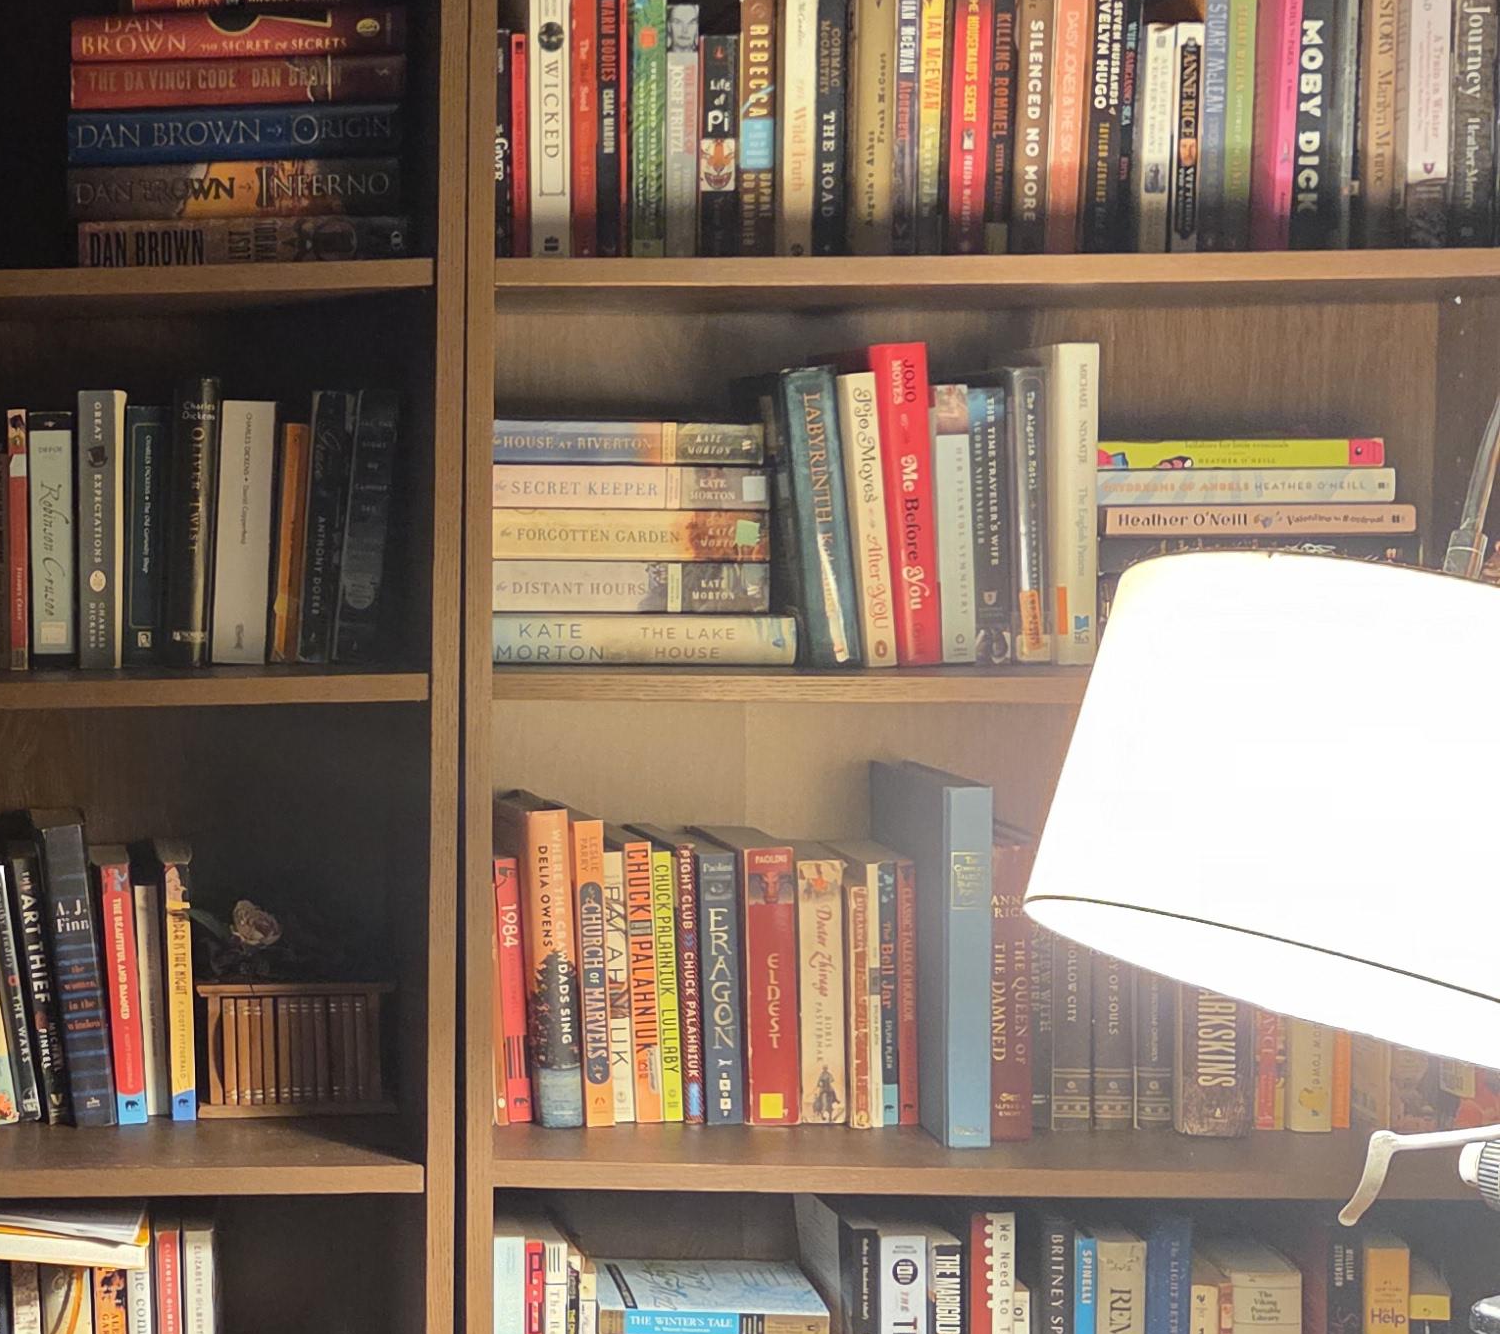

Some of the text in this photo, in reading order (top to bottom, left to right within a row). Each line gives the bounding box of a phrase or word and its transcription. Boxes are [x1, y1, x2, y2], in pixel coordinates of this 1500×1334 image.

[104, 19, 163, 34] DAN
[82, 37, 186, 55] BROWN
[1459, 3, 1494, 100] Journey
[91, 70, 116, 91] THE
[124, 71, 144, 89] DA
[151, 69, 191, 89] VINCI
[198, 69, 236, 88] CODE
[252, 68, 281, 88] DAN
[749, 24, 769, 118] REBECCA
[710, 80, 732, 92] Life
[545, 59, 559, 159] WICKED
[707, 110, 729, 131] Pi
[1024, 20, 1045, 222] SILENCED NO MORE
[1299, 21, 1323, 212] MOBY DICK
[77, 116, 392, 148] DAN BROWN ORIGIN
[822, 112, 835, 218] THE ROAD
[511, 480, 659, 497] SECRET KEEPER
[901, 455, 929, 610] Me Before You
[1118, 512, 1248, 526] Heather O'Neill
[517, 528, 679, 544] FORGOTTEN GARDEN
[519, 623, 584, 639] KATE
[641, 627, 736, 640] THE LAKE
[496, 644, 604, 661] MORTON
[655, 647, 720, 660] HOUSE
[501, 904, 519, 947] 1984
[681, 850, 699, 1078] FIGHT CLUB CHUCK PALAHNIUK
[707, 908, 735, 1049] ERAGON
[767, 953, 780, 1048] ELDEST
[1082, 1250, 1092, 1304] SPINELLI
[1371, 1307, 1405, 1326] Help
